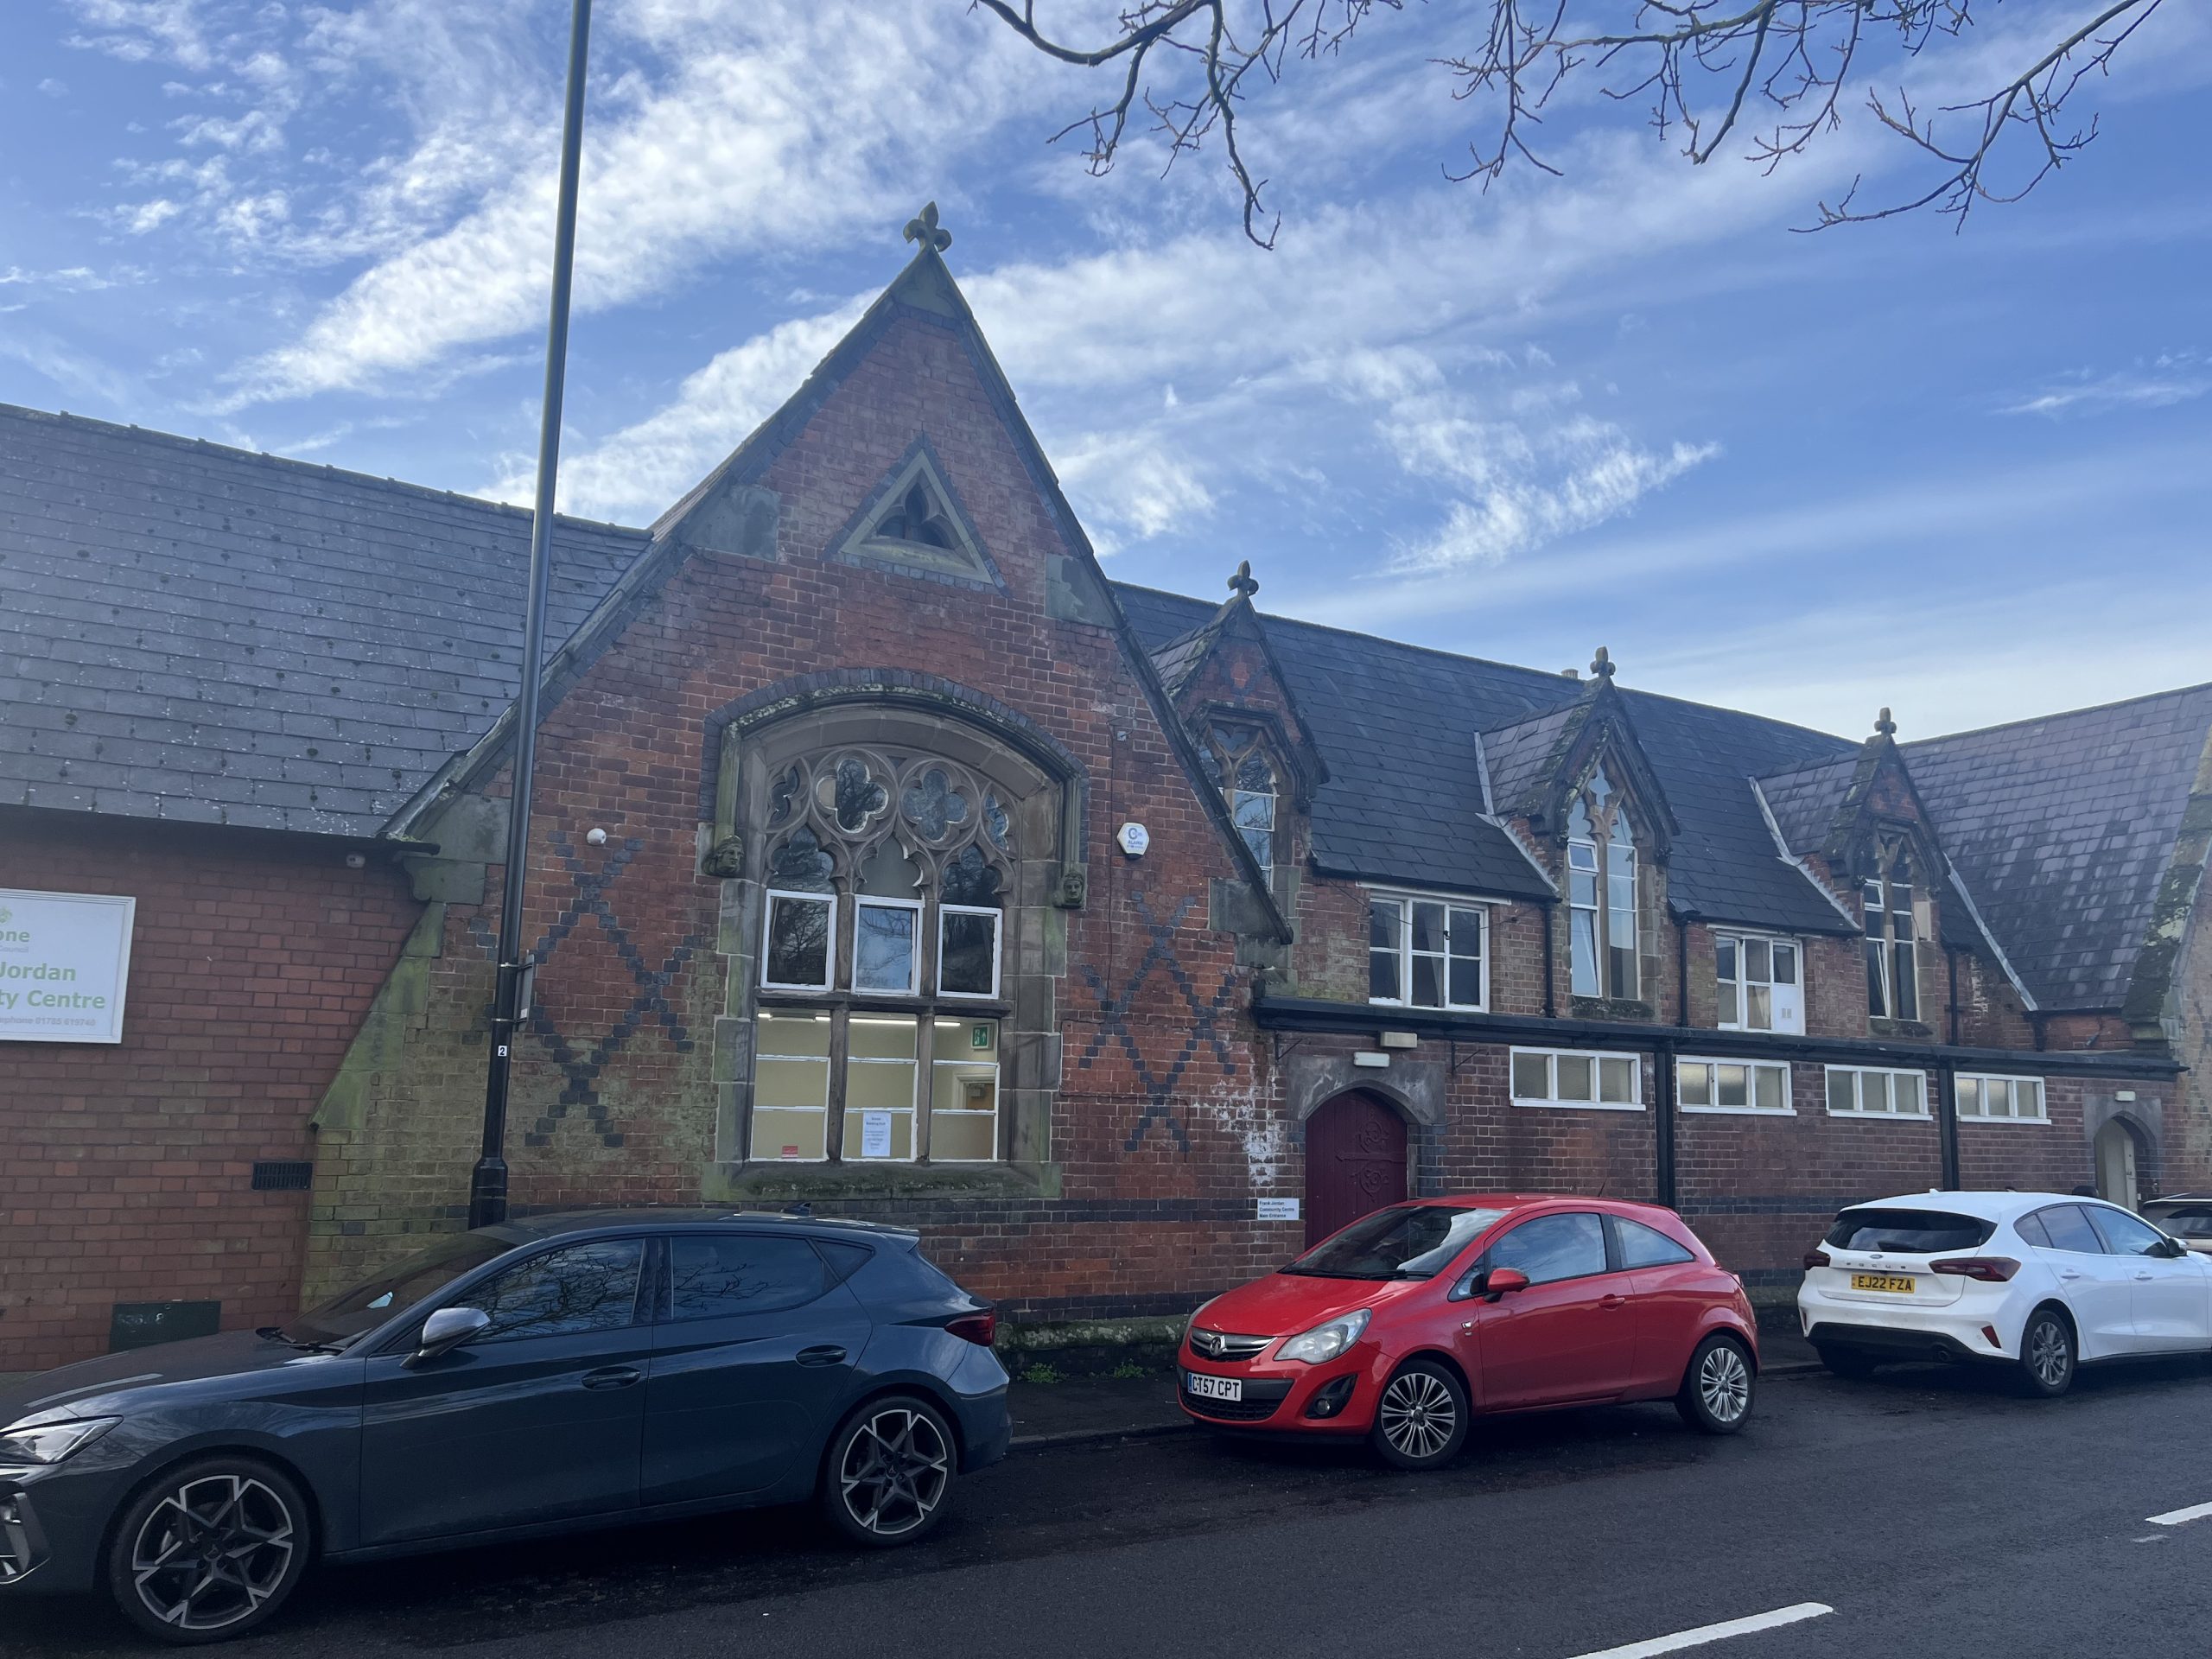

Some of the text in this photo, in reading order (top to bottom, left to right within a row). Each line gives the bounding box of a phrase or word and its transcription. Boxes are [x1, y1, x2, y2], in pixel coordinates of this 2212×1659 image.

[0, 961, 76, 982] Jordan
[27, 989, 105, 1009] Centre
[499, 1046, 505, 1055] 2
[1858, 1275, 1912, 1292] EJ22 FZA
[1192, 1376, 1240, 1398] CT57 CPT
